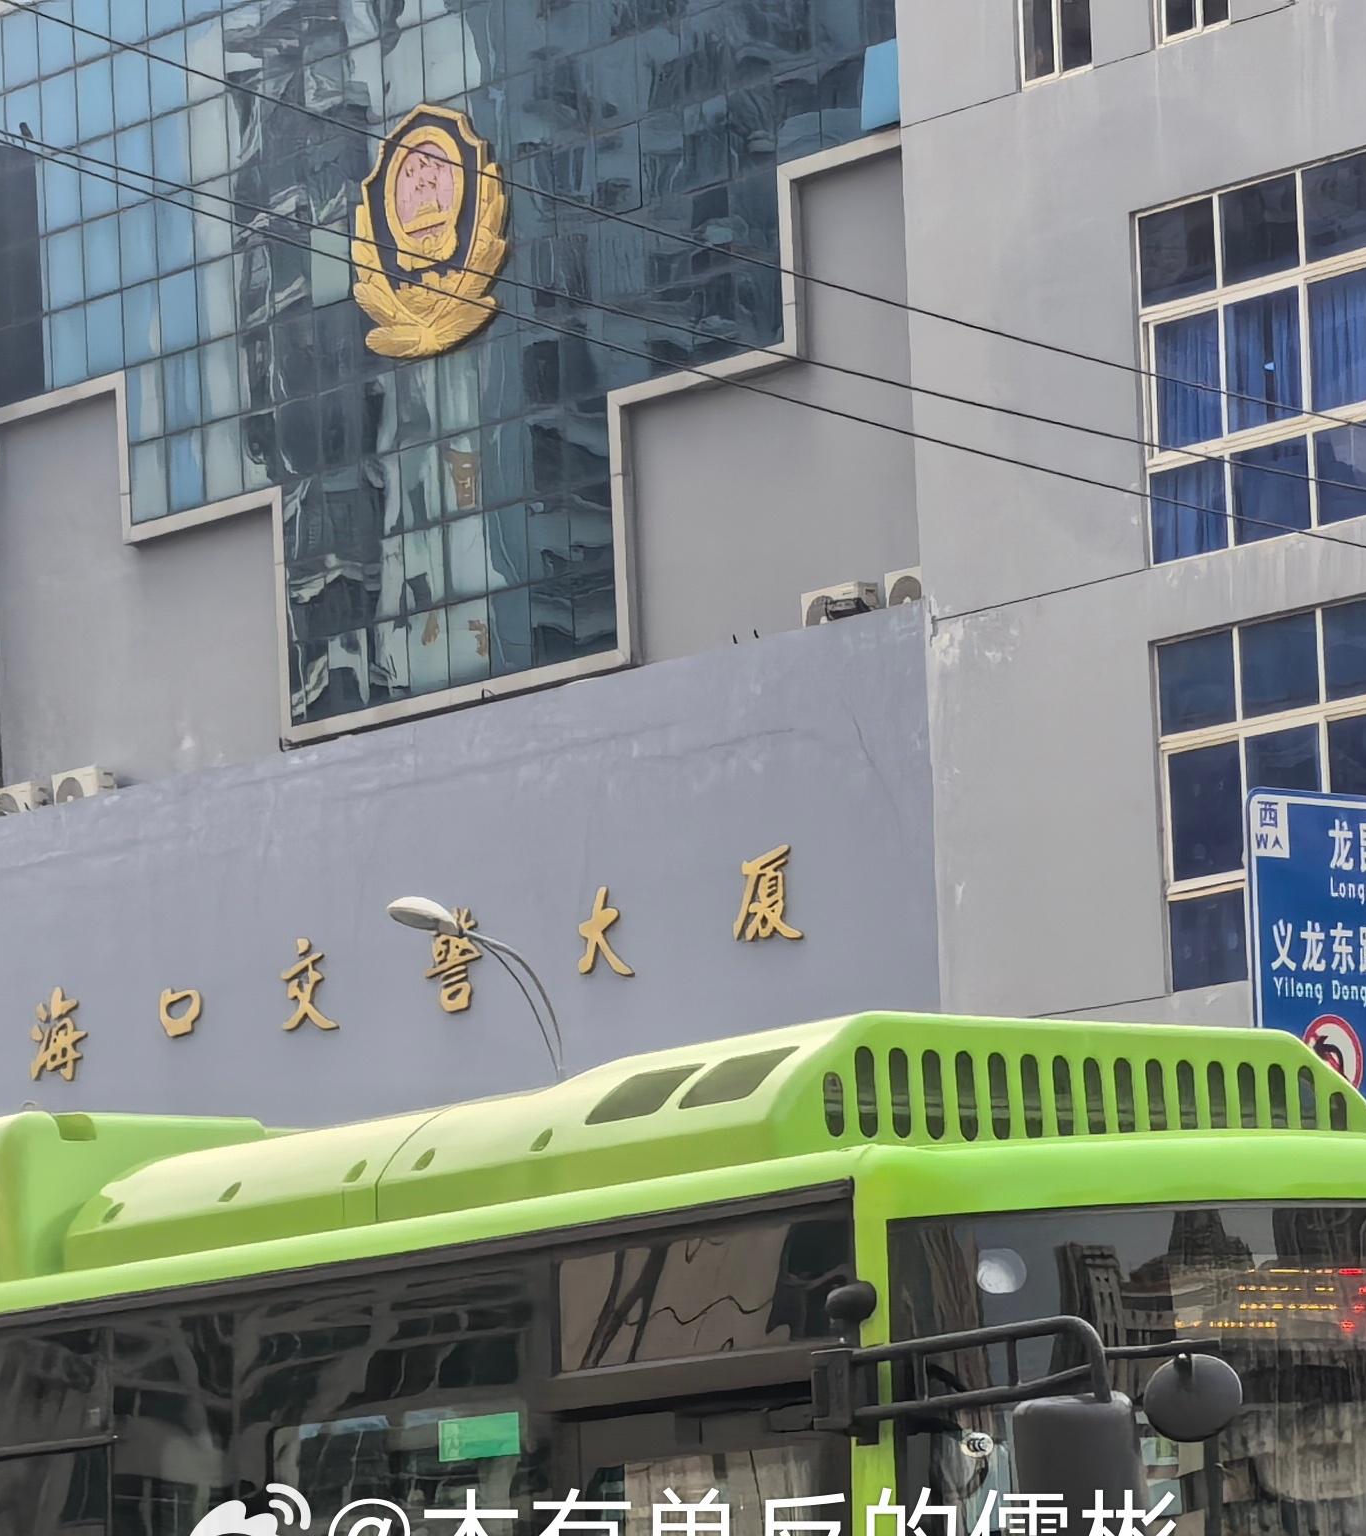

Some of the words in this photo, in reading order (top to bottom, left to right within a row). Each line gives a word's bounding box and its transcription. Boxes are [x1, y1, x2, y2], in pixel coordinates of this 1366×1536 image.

[1257, 801, 1278, 828] 西
[29, 844, 803, 1083] 海口交警大厦
[1273, 976, 1324, 1005] Yilong
